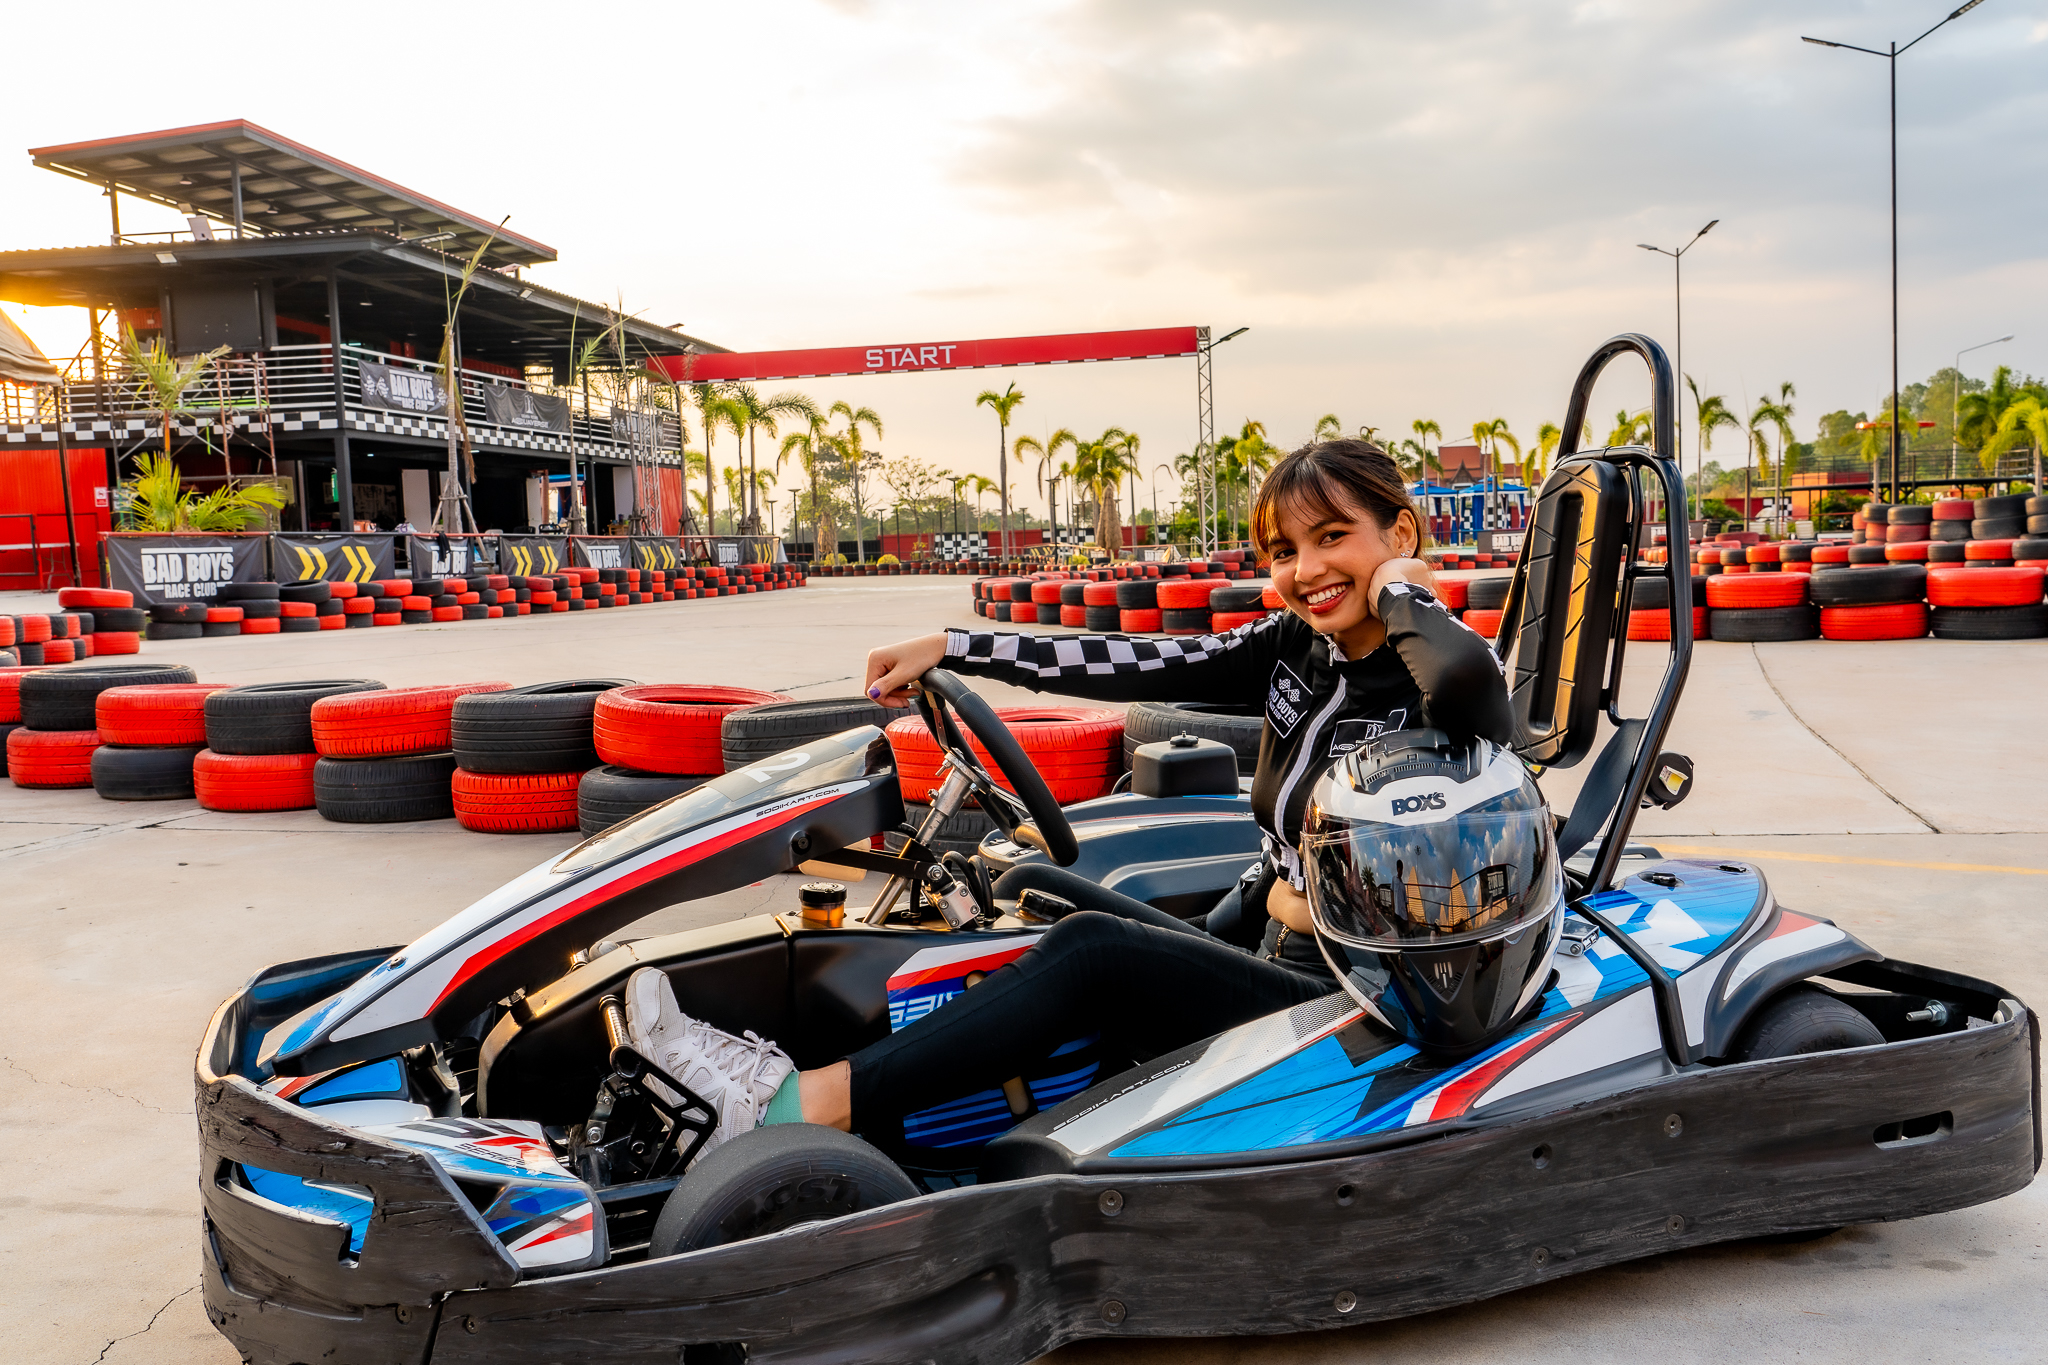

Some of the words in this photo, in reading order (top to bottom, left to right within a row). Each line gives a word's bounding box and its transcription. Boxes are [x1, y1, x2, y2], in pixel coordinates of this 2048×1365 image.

[866, 345, 956, 368] START
[390, 374, 410, 397] BAD
[410, 378, 434, 401] BOYS
[141, 554, 183, 584] BAD
[186, 553, 234, 582] BOYS
[602, 550, 621, 568] BOYS
[164, 583, 190, 598] RACE
[193, 582, 217, 597] CLUB
[1276, 697, 1298, 723] BOYS
[743, 752, 811, 783] 2
[756, 788, 839, 817] SODIKART.COM
[1053, 1060, 1191, 1131] SODIKART.COM
